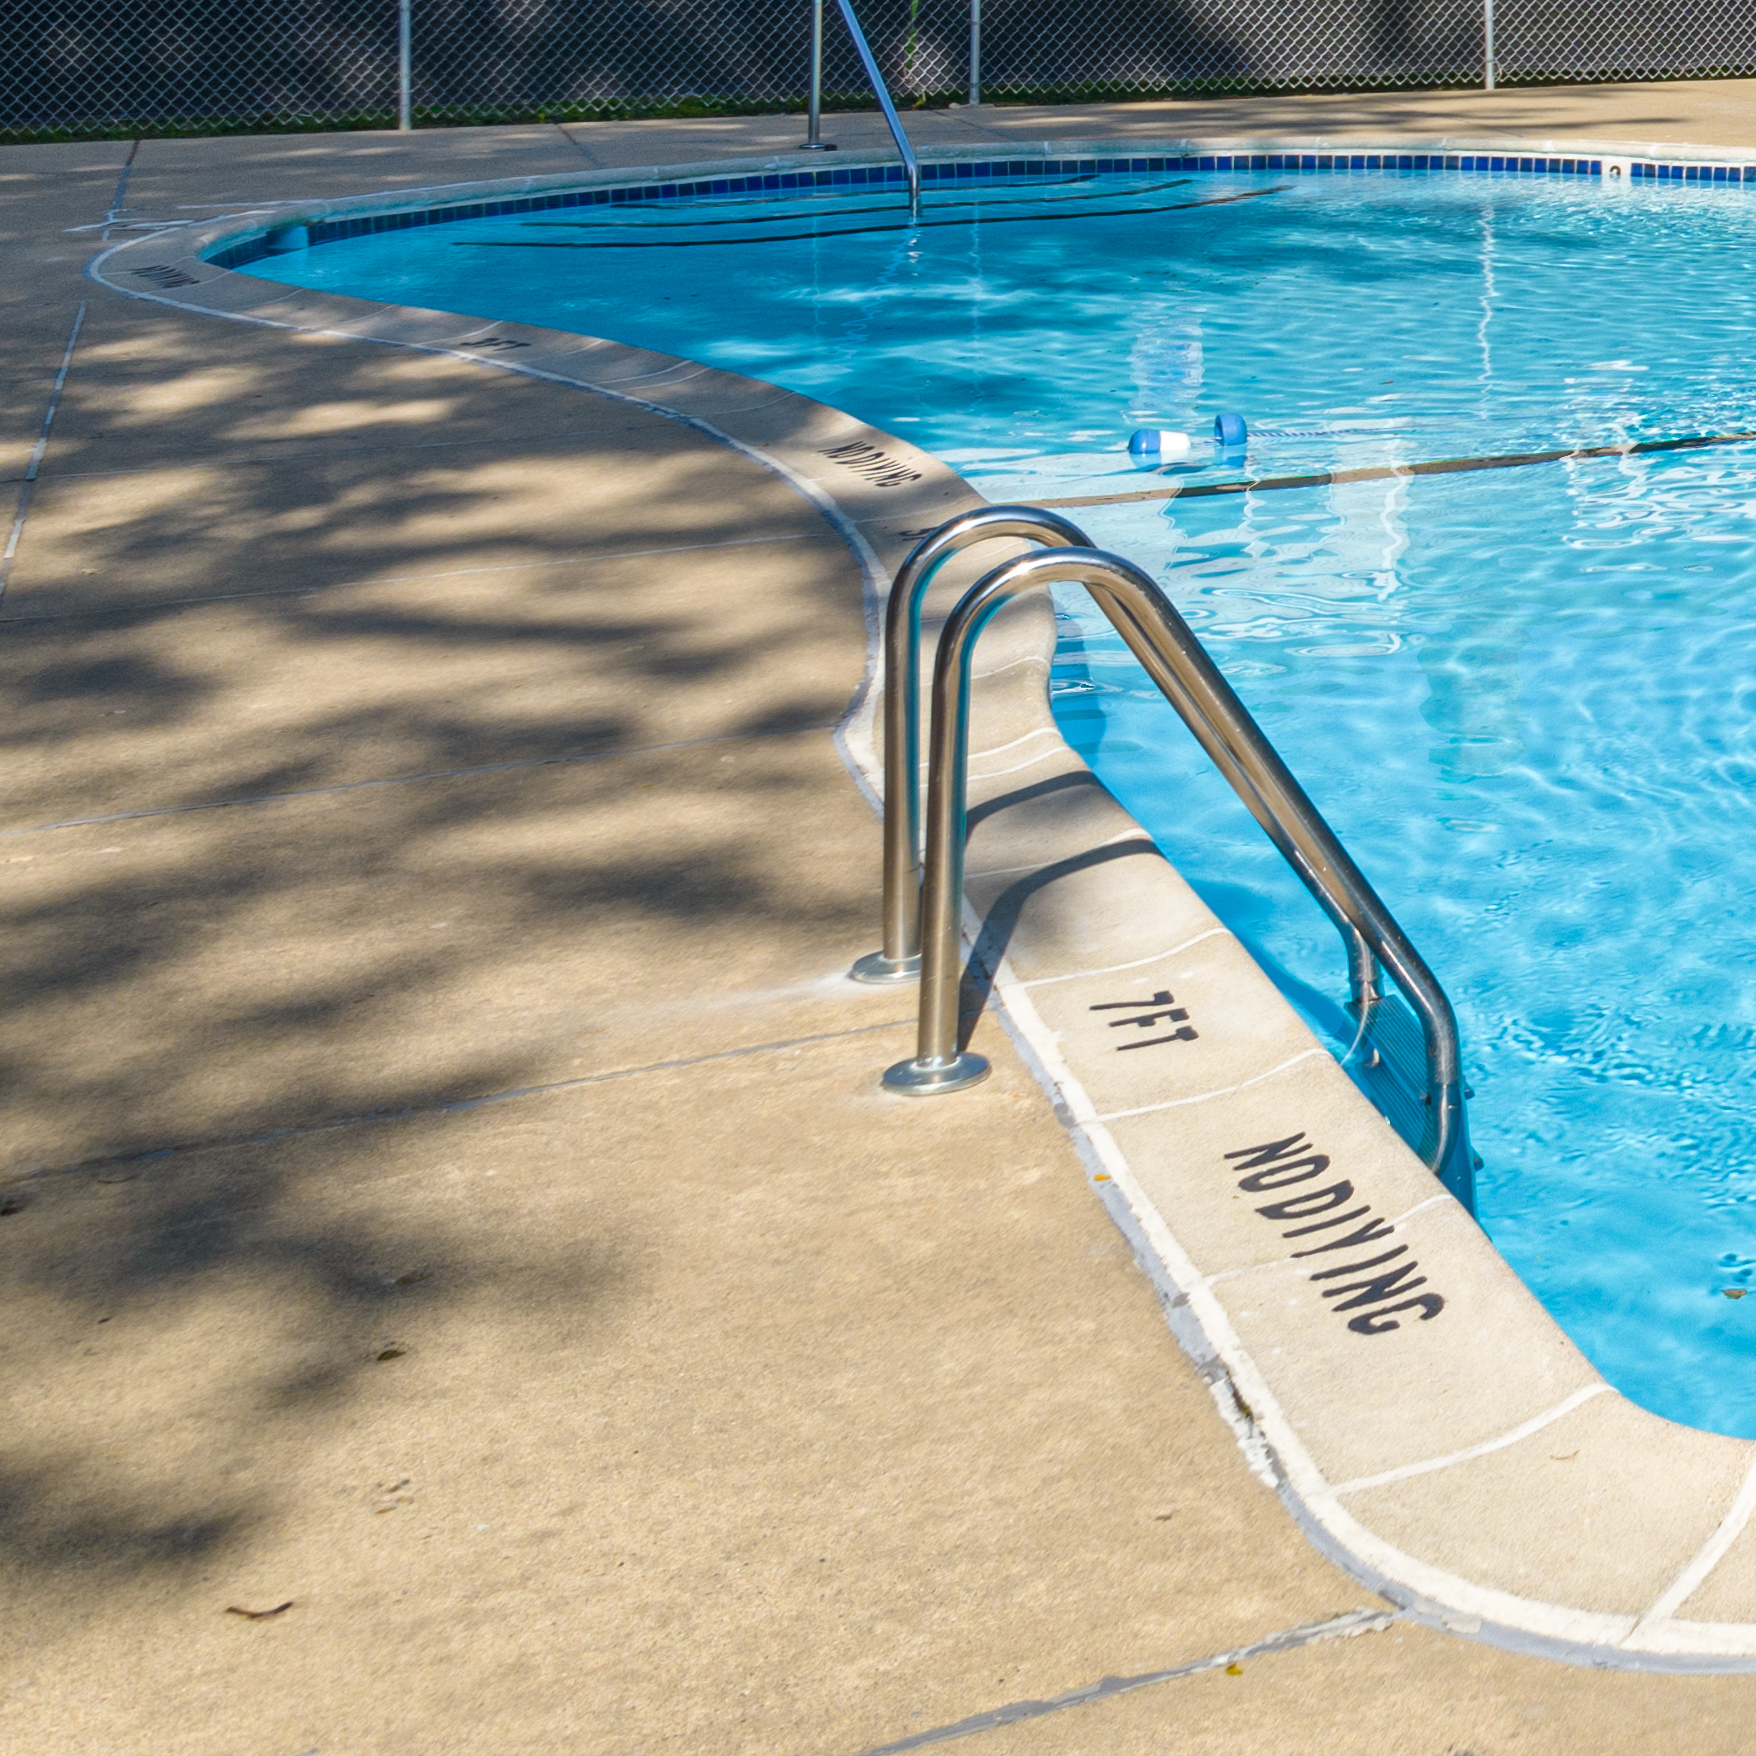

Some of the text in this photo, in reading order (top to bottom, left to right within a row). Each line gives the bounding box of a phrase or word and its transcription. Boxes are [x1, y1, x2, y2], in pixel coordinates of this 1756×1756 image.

[817, 440, 922, 487] NO DIVING
[1089, 989, 1200, 1051] 7FT
[1223, 1131, 1445, 1336] NO DIVING
